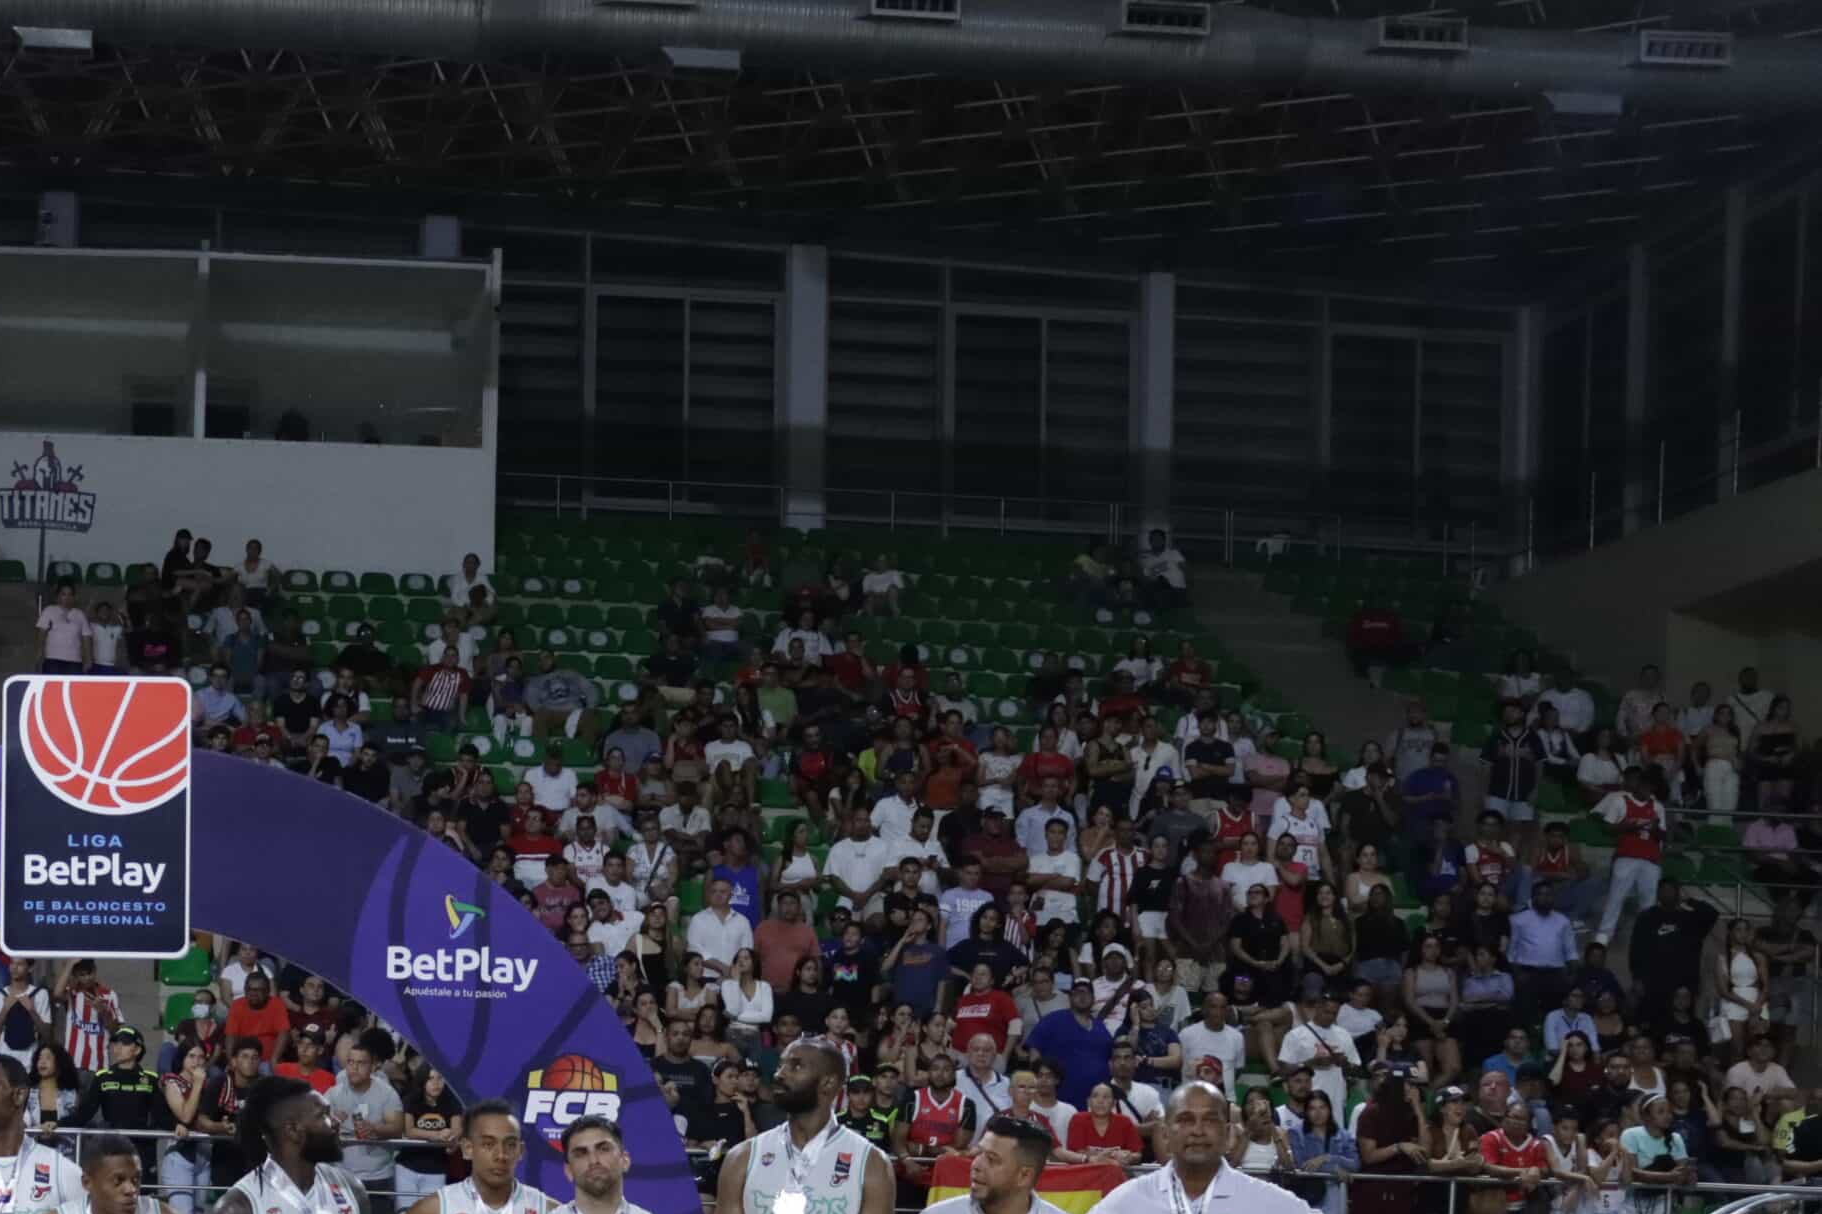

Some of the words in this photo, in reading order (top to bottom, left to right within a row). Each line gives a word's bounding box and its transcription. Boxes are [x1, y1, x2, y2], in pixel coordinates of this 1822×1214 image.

[67, 834, 123, 847] LIGA
[24, 852, 166, 894] BetPlay
[24, 901, 45, 910] DE
[51, 901, 166, 912] BALONCESTO
[35, 914, 154, 925] PROFESIONAL
[386, 945, 538, 992] BetPlay
[403, 986, 451, 997] Apuéstale
[454, 989, 460, 997] a
[463, 989, 473, 998] tu
[475, 989, 507, 999] pasión
[523, 1090, 621, 1125] FCB
